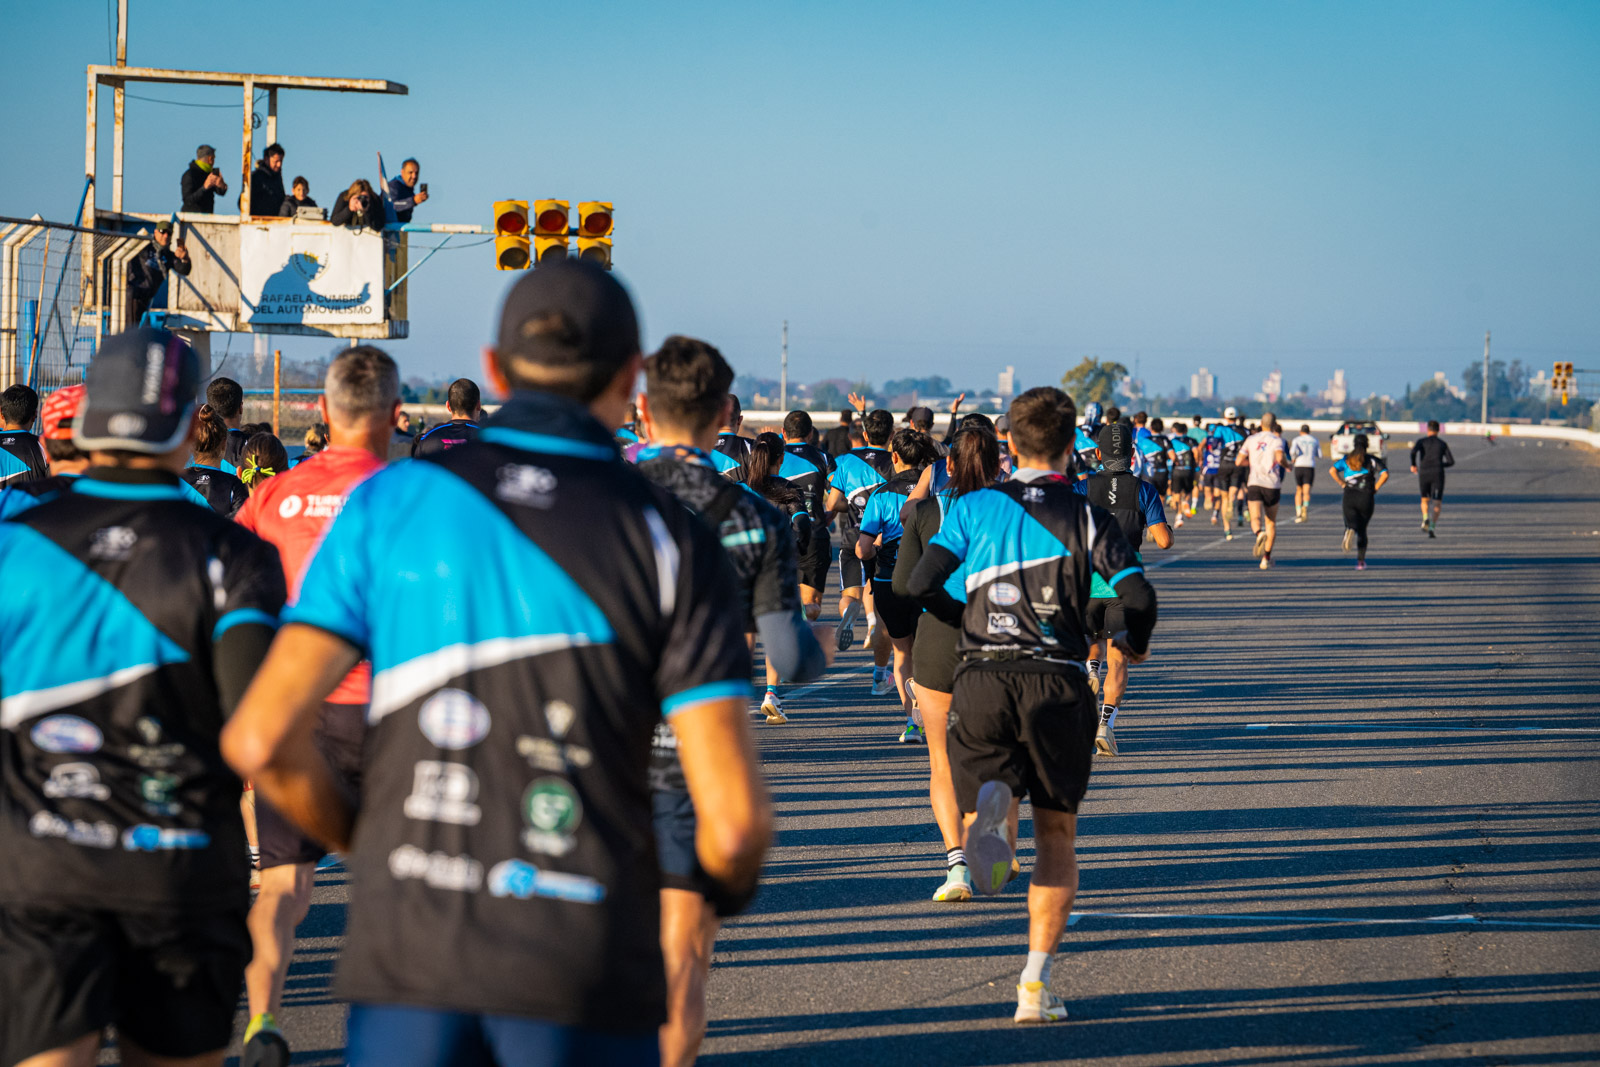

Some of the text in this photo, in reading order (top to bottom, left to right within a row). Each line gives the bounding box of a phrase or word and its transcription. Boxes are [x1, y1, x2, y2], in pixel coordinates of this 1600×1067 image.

[261, 294, 363, 303] RAFAELA CUMBRE
[253, 305, 372, 315] DEL AUTOMOVILISMO
